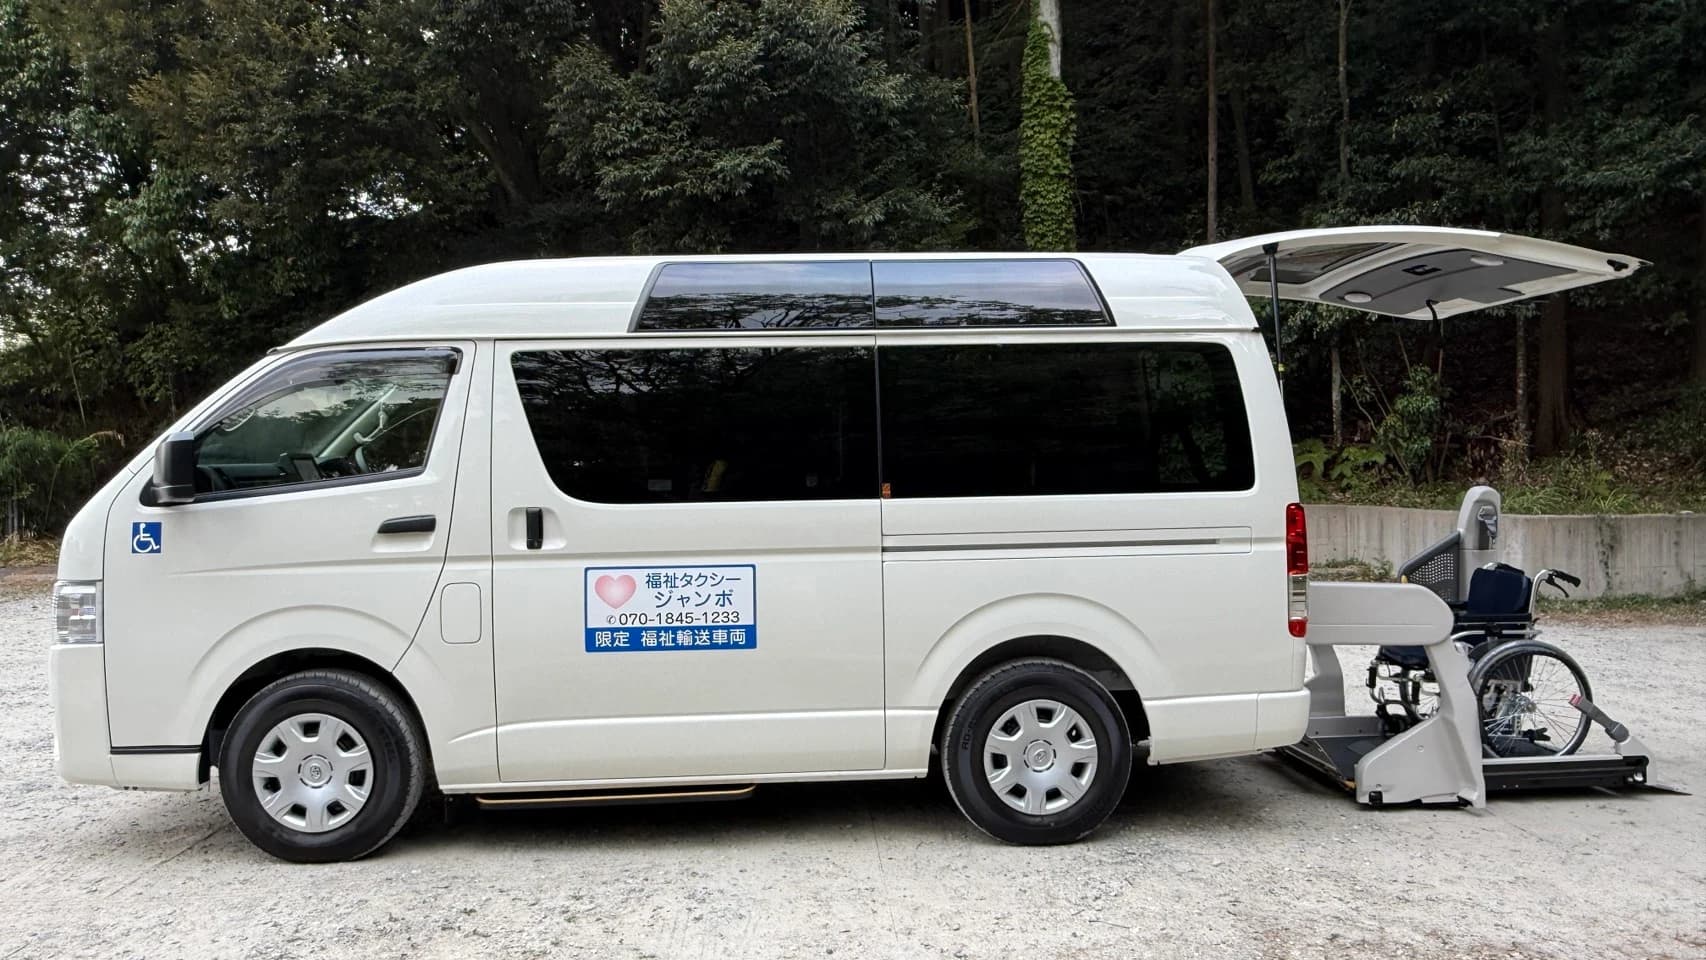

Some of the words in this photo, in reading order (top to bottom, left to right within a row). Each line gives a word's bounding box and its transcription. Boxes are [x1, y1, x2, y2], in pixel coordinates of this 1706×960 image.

[645, 572, 741, 589] 福祉タクシー
[654, 589, 734, 609] ジャンボ
[619, 611, 740, 626] 070-1845-1233
[595, 630, 631, 648] 限定
[640, 628, 746, 647] 福祉輸送車両
